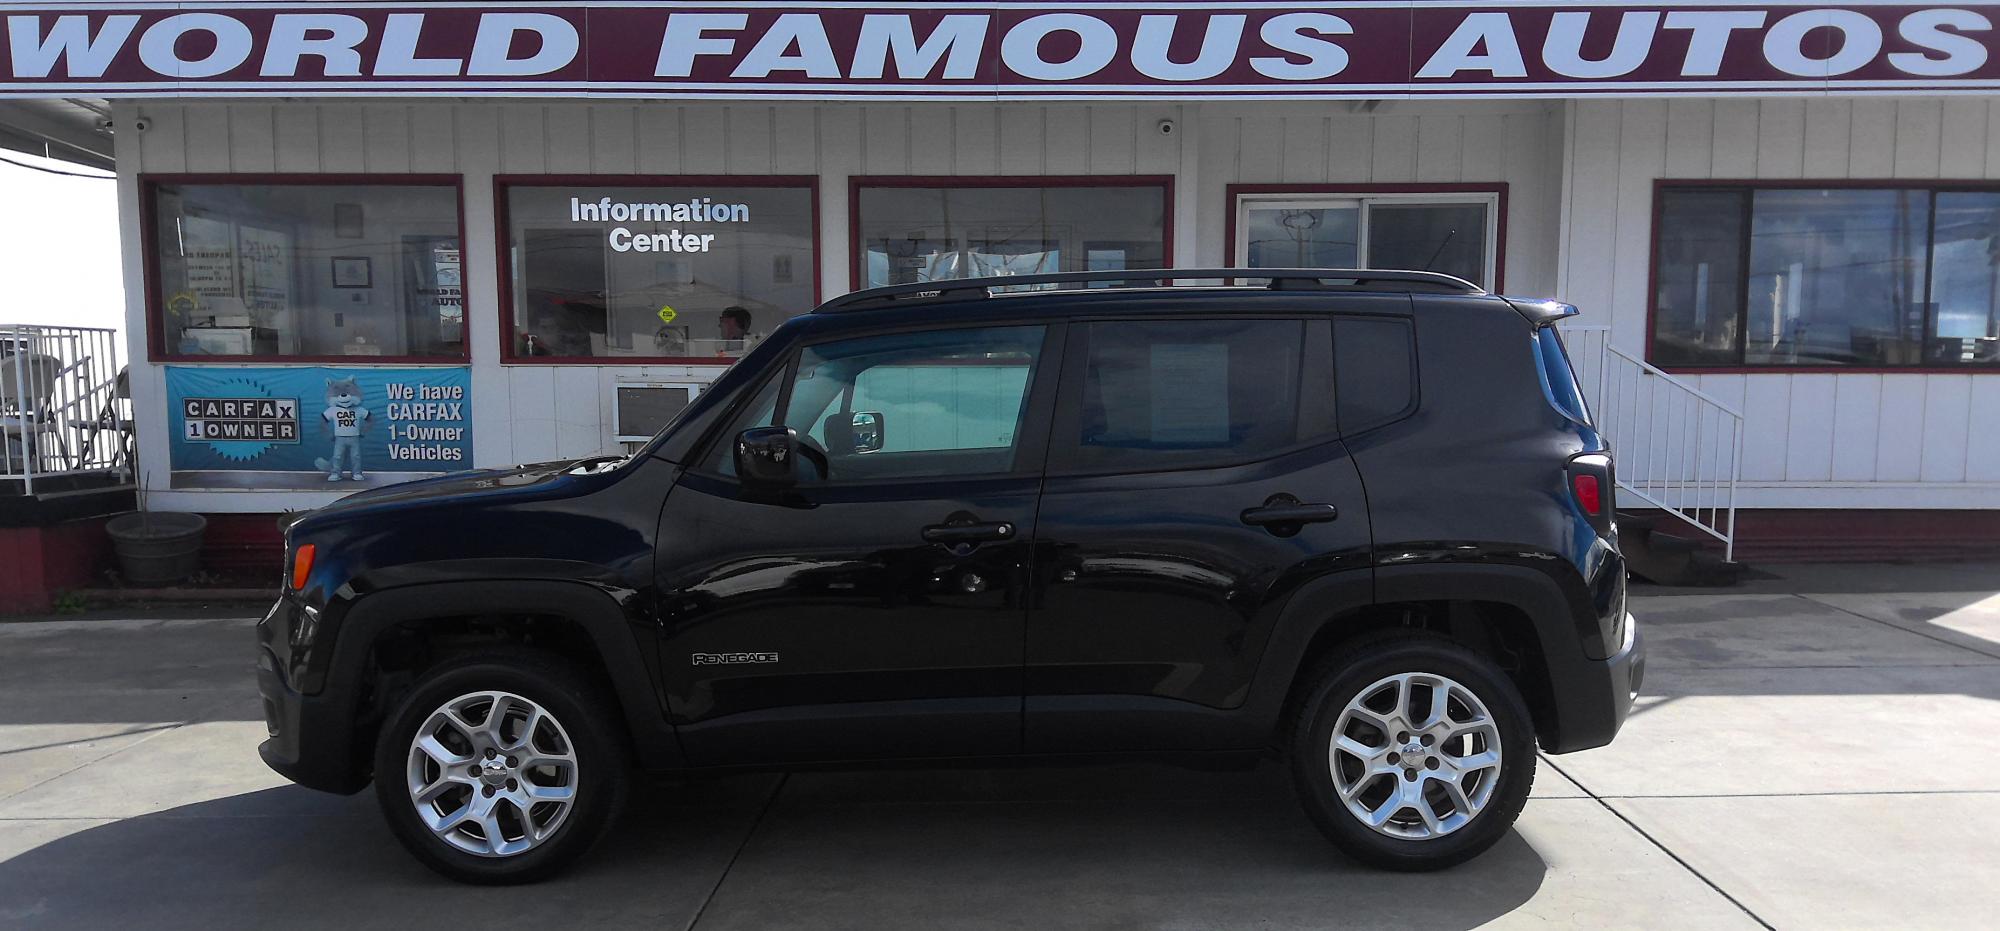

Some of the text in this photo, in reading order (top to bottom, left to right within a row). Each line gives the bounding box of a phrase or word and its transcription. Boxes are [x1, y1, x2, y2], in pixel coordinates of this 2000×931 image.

[7, 9, 1993, 80] WORLD FAMOUS AUTOS
[571, 197, 750, 222] Information
[609, 227, 715, 253] Center
[386, 383, 462, 400] We have
[187, 402, 292, 419] CARFAX
[336, 411, 356, 419] CAR
[387, 402, 462, 421] CARFAX
[207, 424, 293, 437] OWNER
[338, 419, 356, 428] FOX
[388, 424, 464, 441] 1-Owner
[388, 444, 462, 460] Vehicles
[692, 652, 779, 666] RENEGADE
